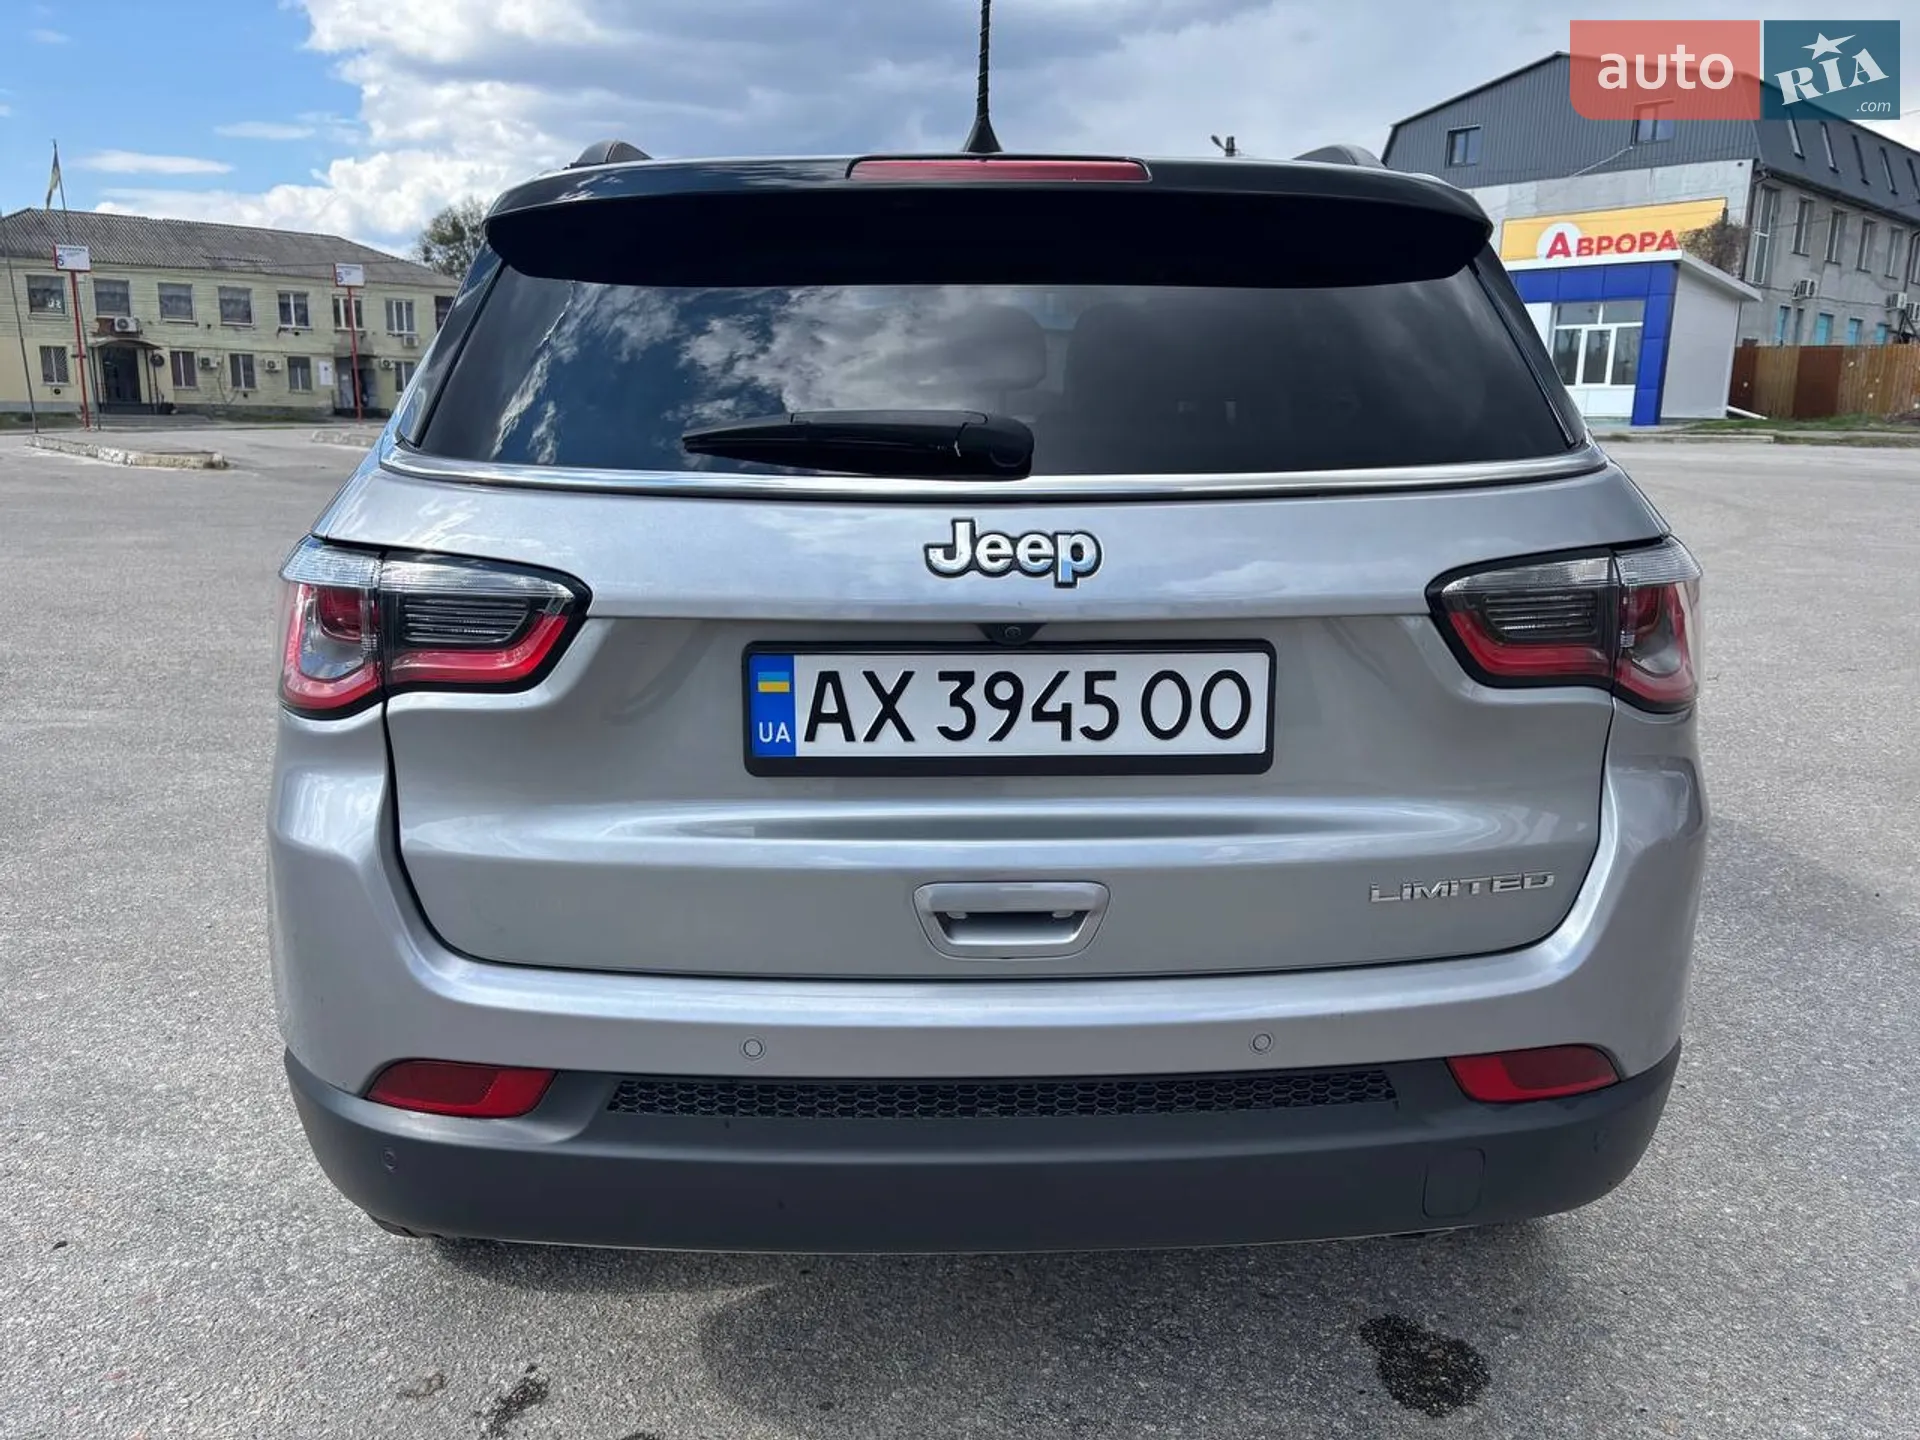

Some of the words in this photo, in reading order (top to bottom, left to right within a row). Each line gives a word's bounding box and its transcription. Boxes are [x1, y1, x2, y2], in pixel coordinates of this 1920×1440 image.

[924, 517, 1102, 588] Jeep
[803, 670, 916, 743] AX
[936, 669, 1120, 742] 3945
[758, 722, 791, 744] UA
[1369, 871, 1556, 903] LIMITED
